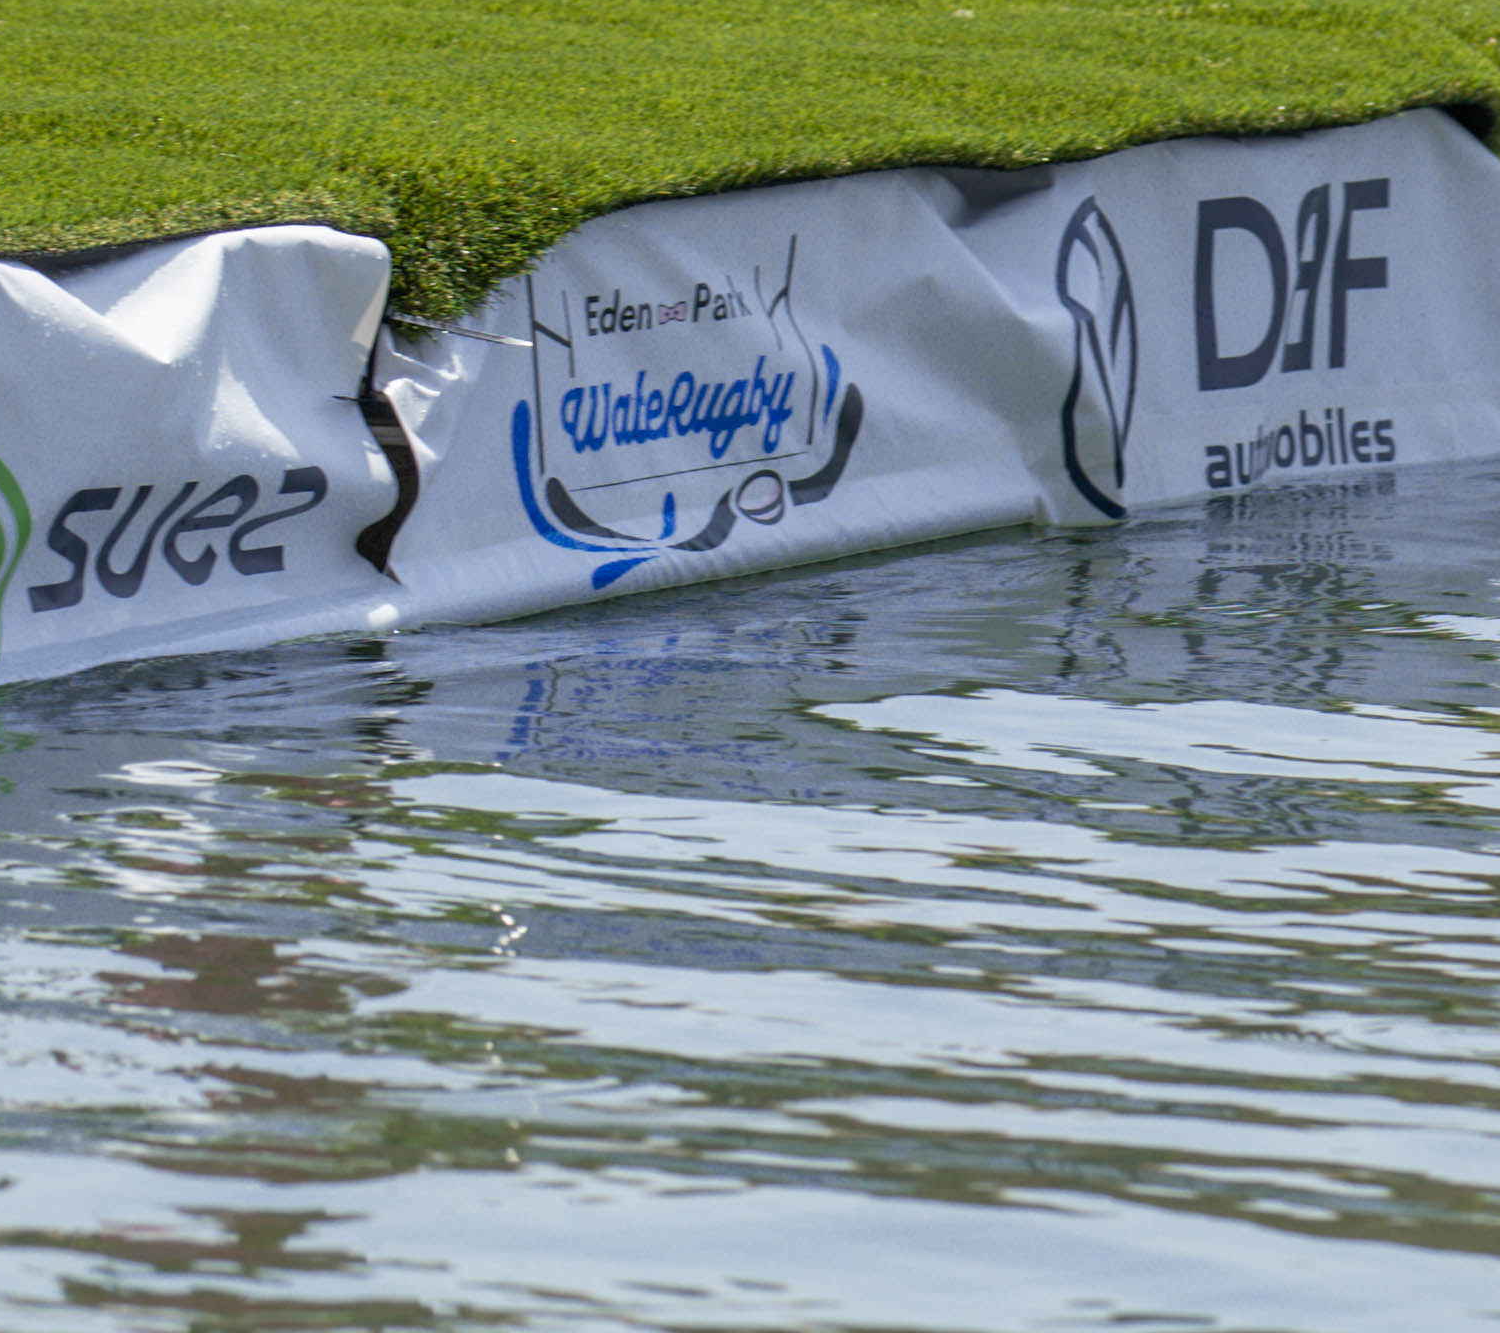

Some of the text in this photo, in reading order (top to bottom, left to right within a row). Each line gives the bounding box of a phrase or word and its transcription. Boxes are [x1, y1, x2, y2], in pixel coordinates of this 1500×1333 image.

[586, 282, 753, 336] Eden Park
[561, 355, 797, 460] WateRugby
